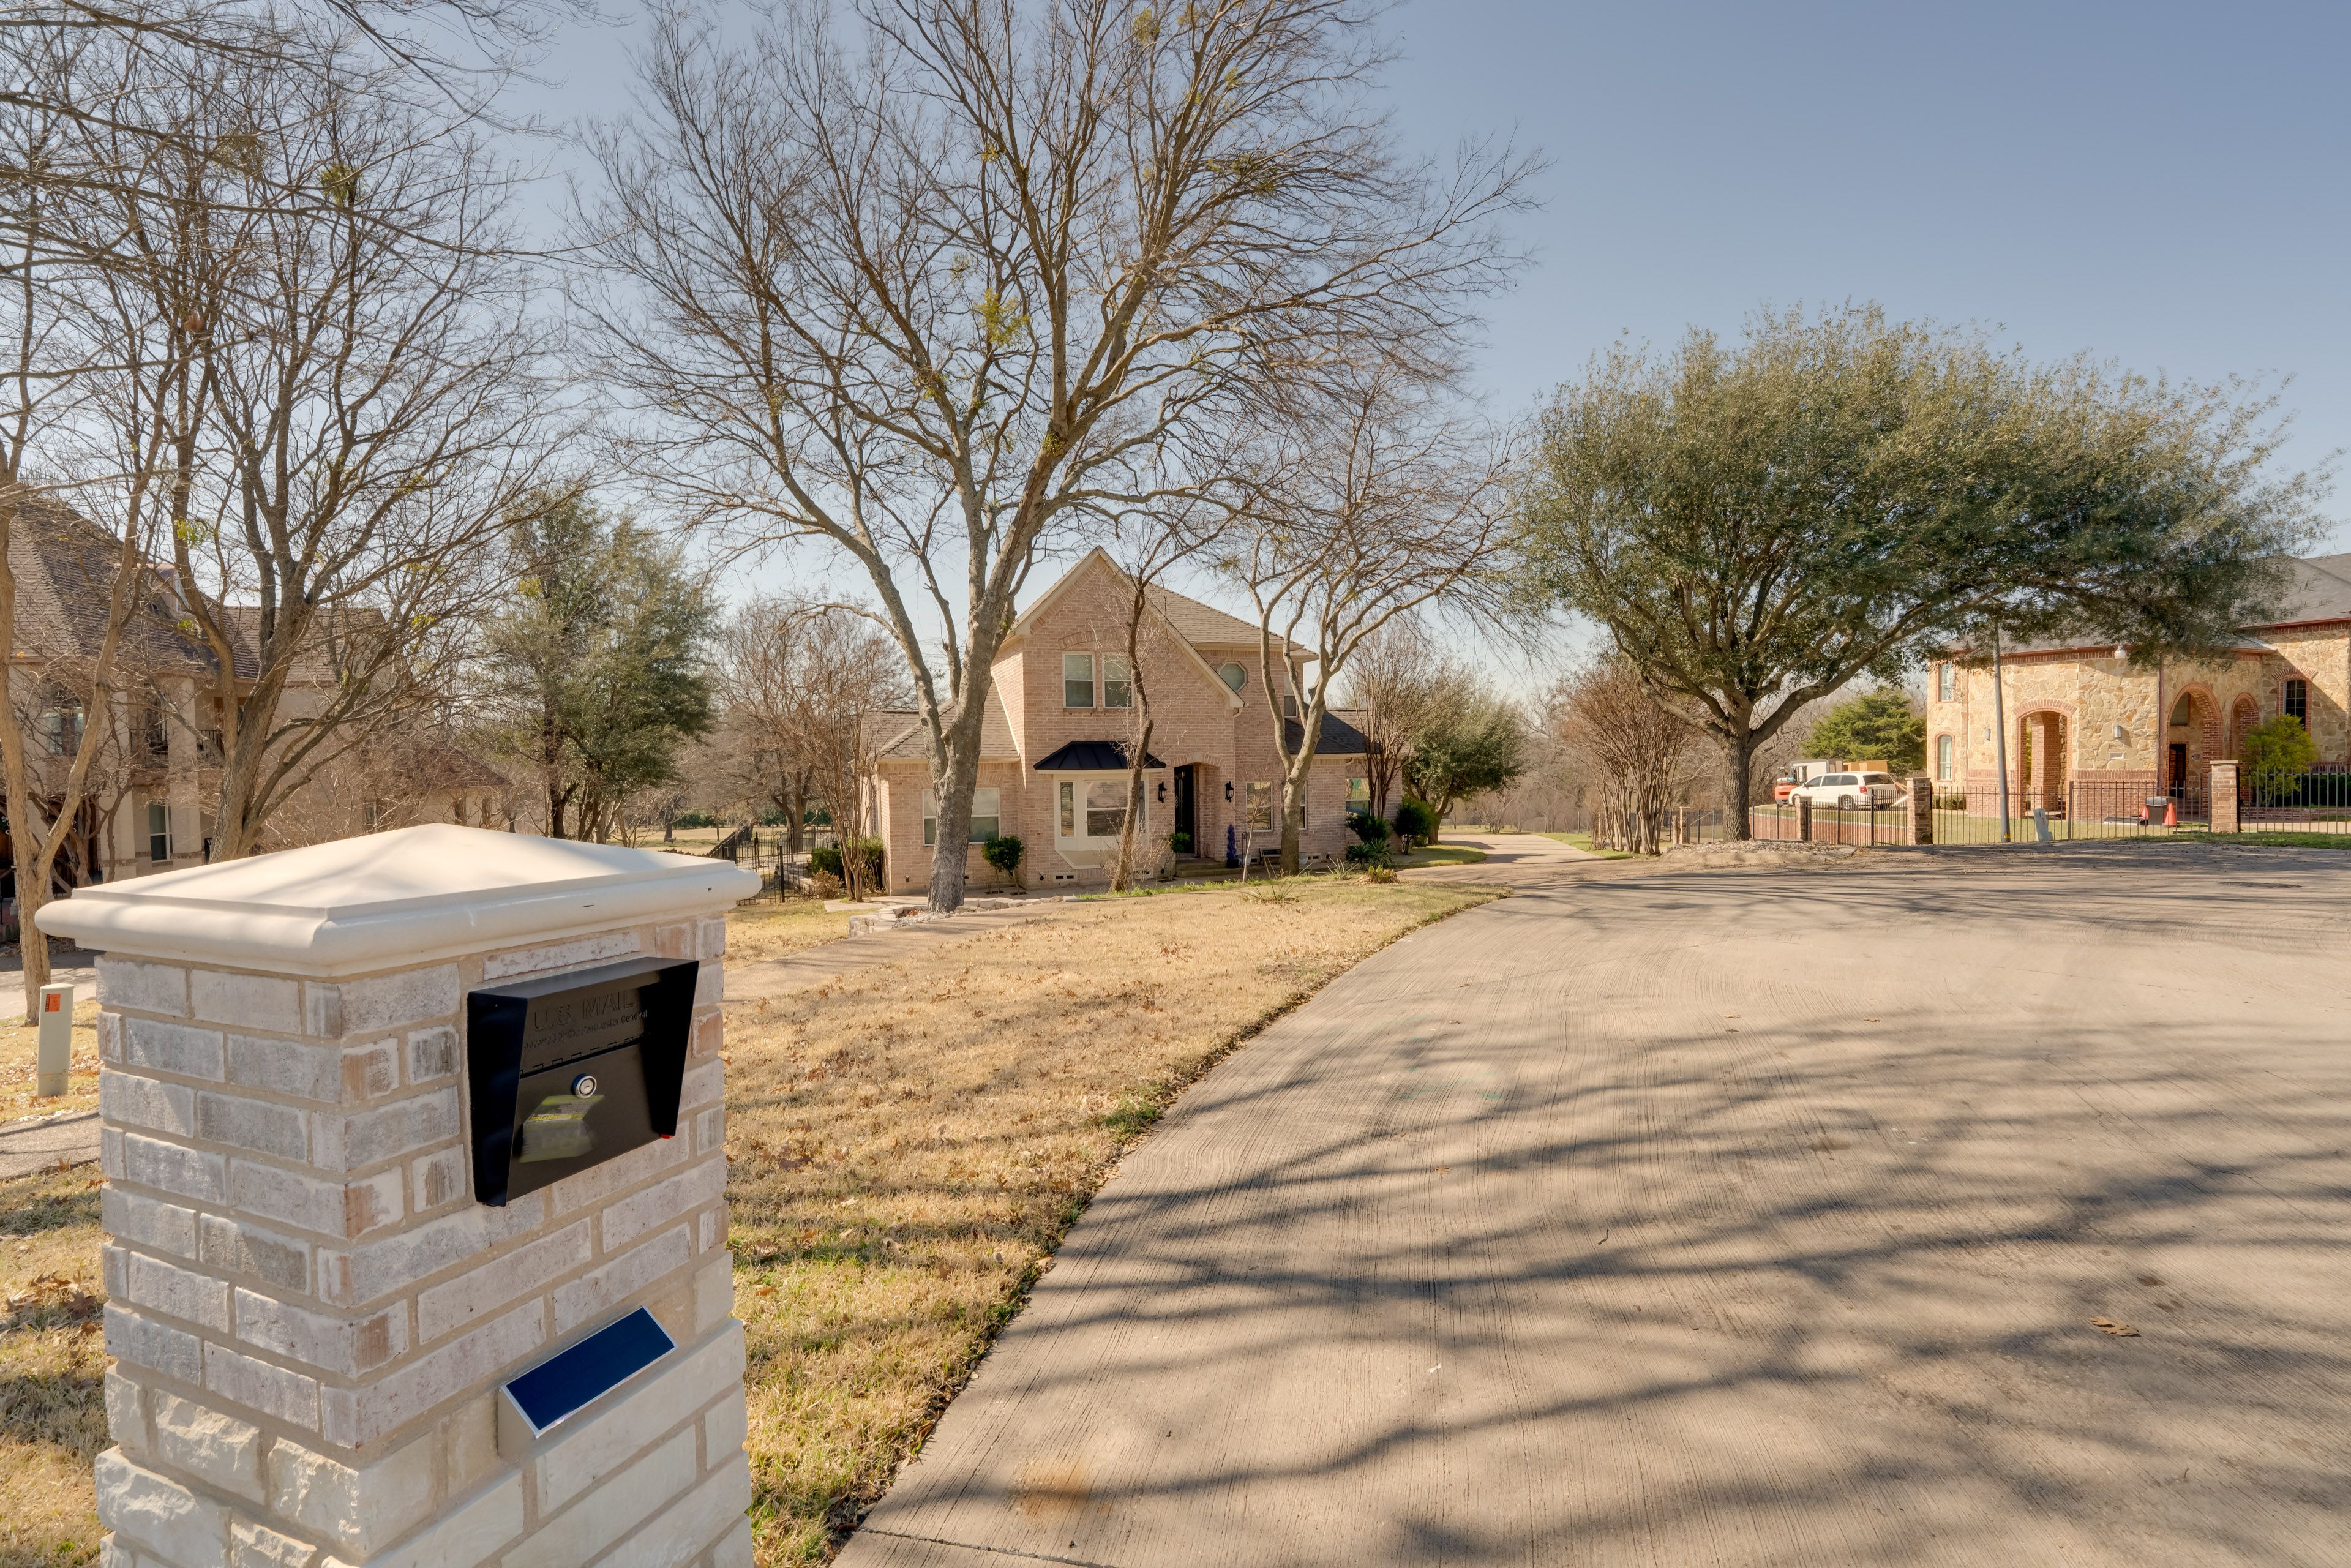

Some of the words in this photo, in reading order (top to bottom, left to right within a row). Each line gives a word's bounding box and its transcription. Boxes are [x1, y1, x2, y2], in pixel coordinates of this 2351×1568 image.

[534, 1003, 577, 1032] U.S.
[583, 990, 634, 1019] MAIL
[621, 1008, 648, 1024] General
